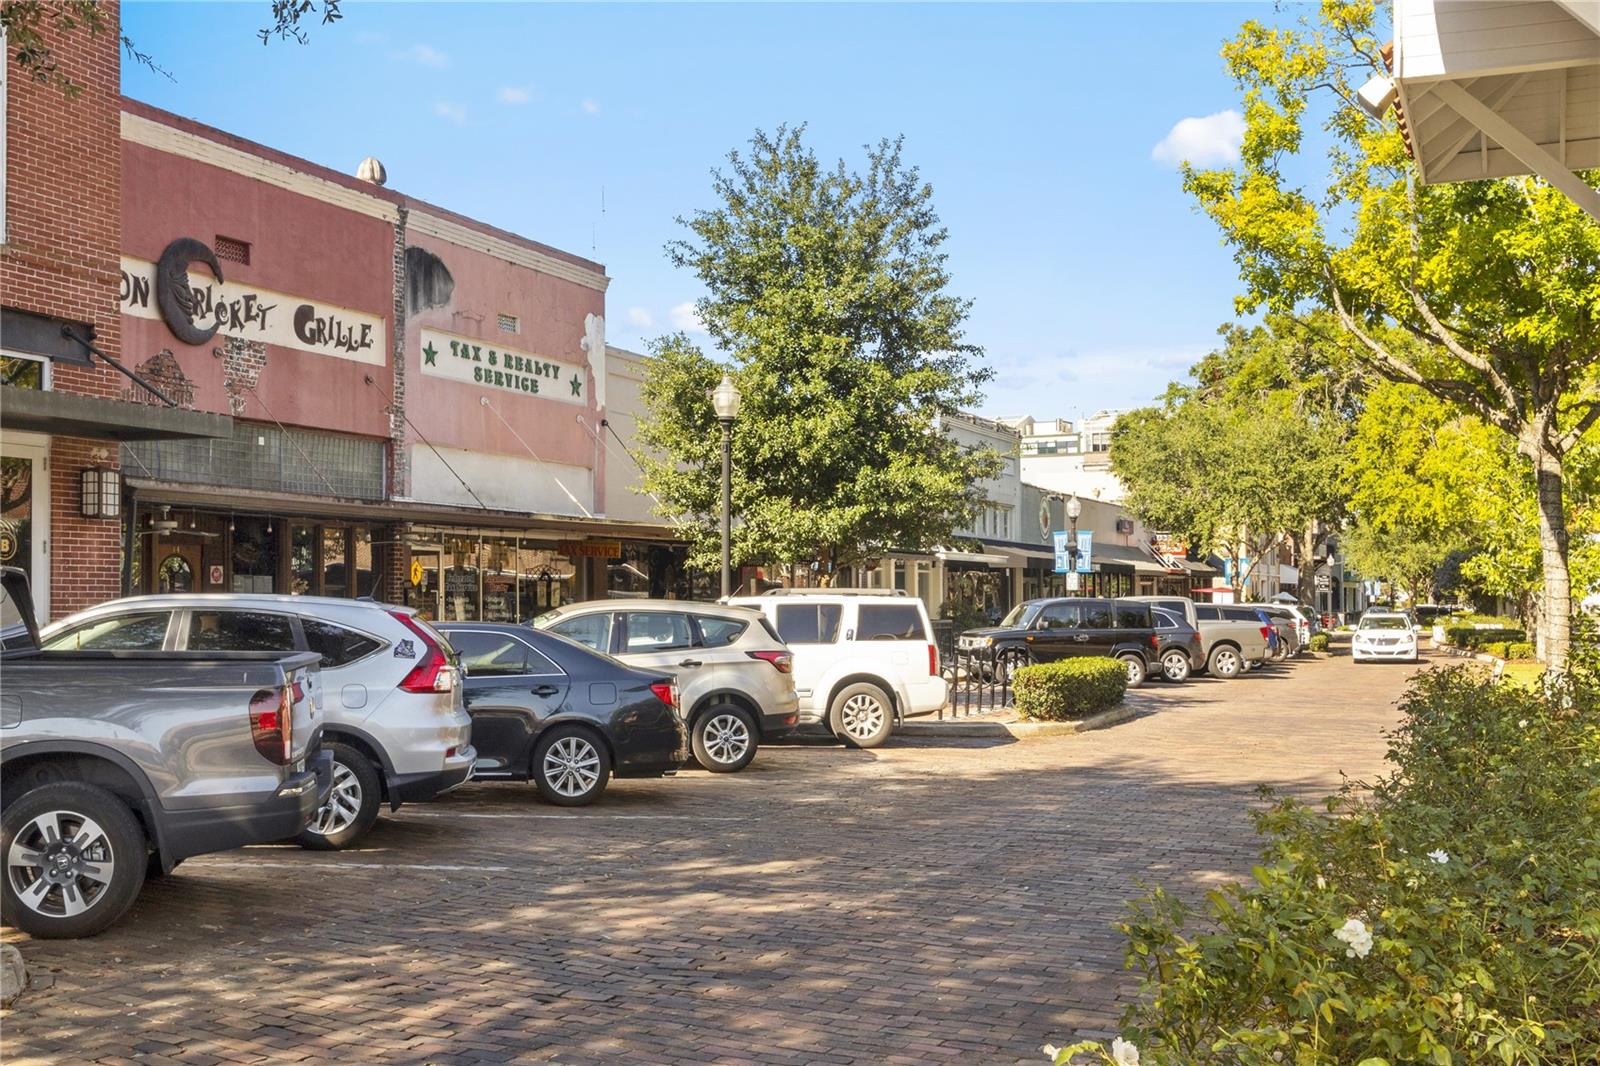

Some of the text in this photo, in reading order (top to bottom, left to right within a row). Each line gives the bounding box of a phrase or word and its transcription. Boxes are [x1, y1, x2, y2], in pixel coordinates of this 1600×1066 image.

[293, 304, 374, 353] GRILLE
[450, 340, 561, 380] TAX & REALTY
[473, 366, 539, 394] SERVICE
